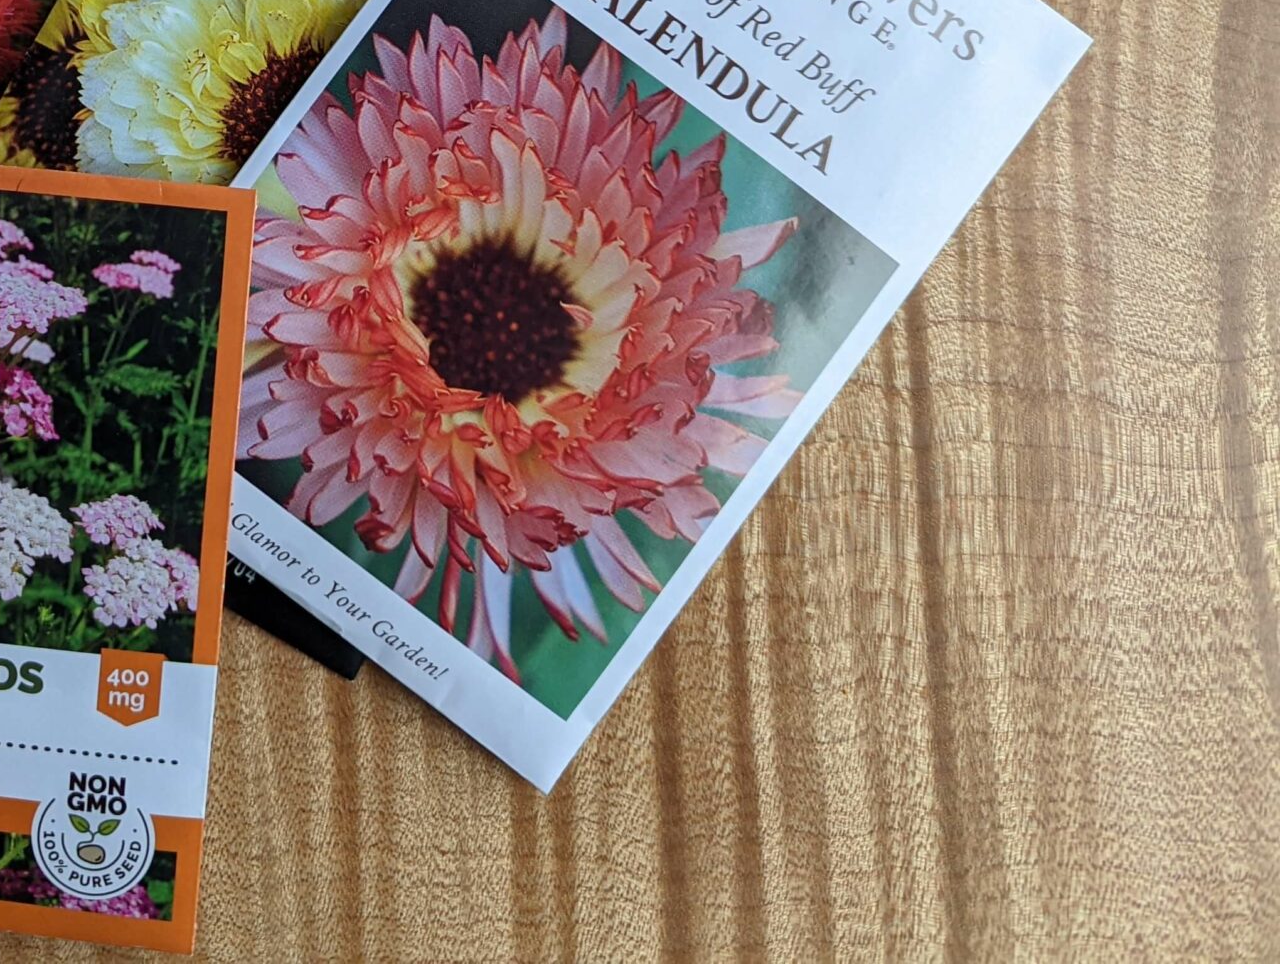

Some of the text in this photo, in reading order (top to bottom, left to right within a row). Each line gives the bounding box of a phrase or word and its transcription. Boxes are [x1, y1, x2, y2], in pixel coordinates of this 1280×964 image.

[740, 10, 805, 62] Red
[796, 49, 876, 115] Buff
[231, 513, 450, 680] Glamor to Your Garden!
[106, 668, 149, 687] 400
[108, 690, 145, 712] mg
[69, 771, 126, 797] NON
[67, 792, 127, 816] GMO
[43, 830, 142, 888] 100% PURE SEED
